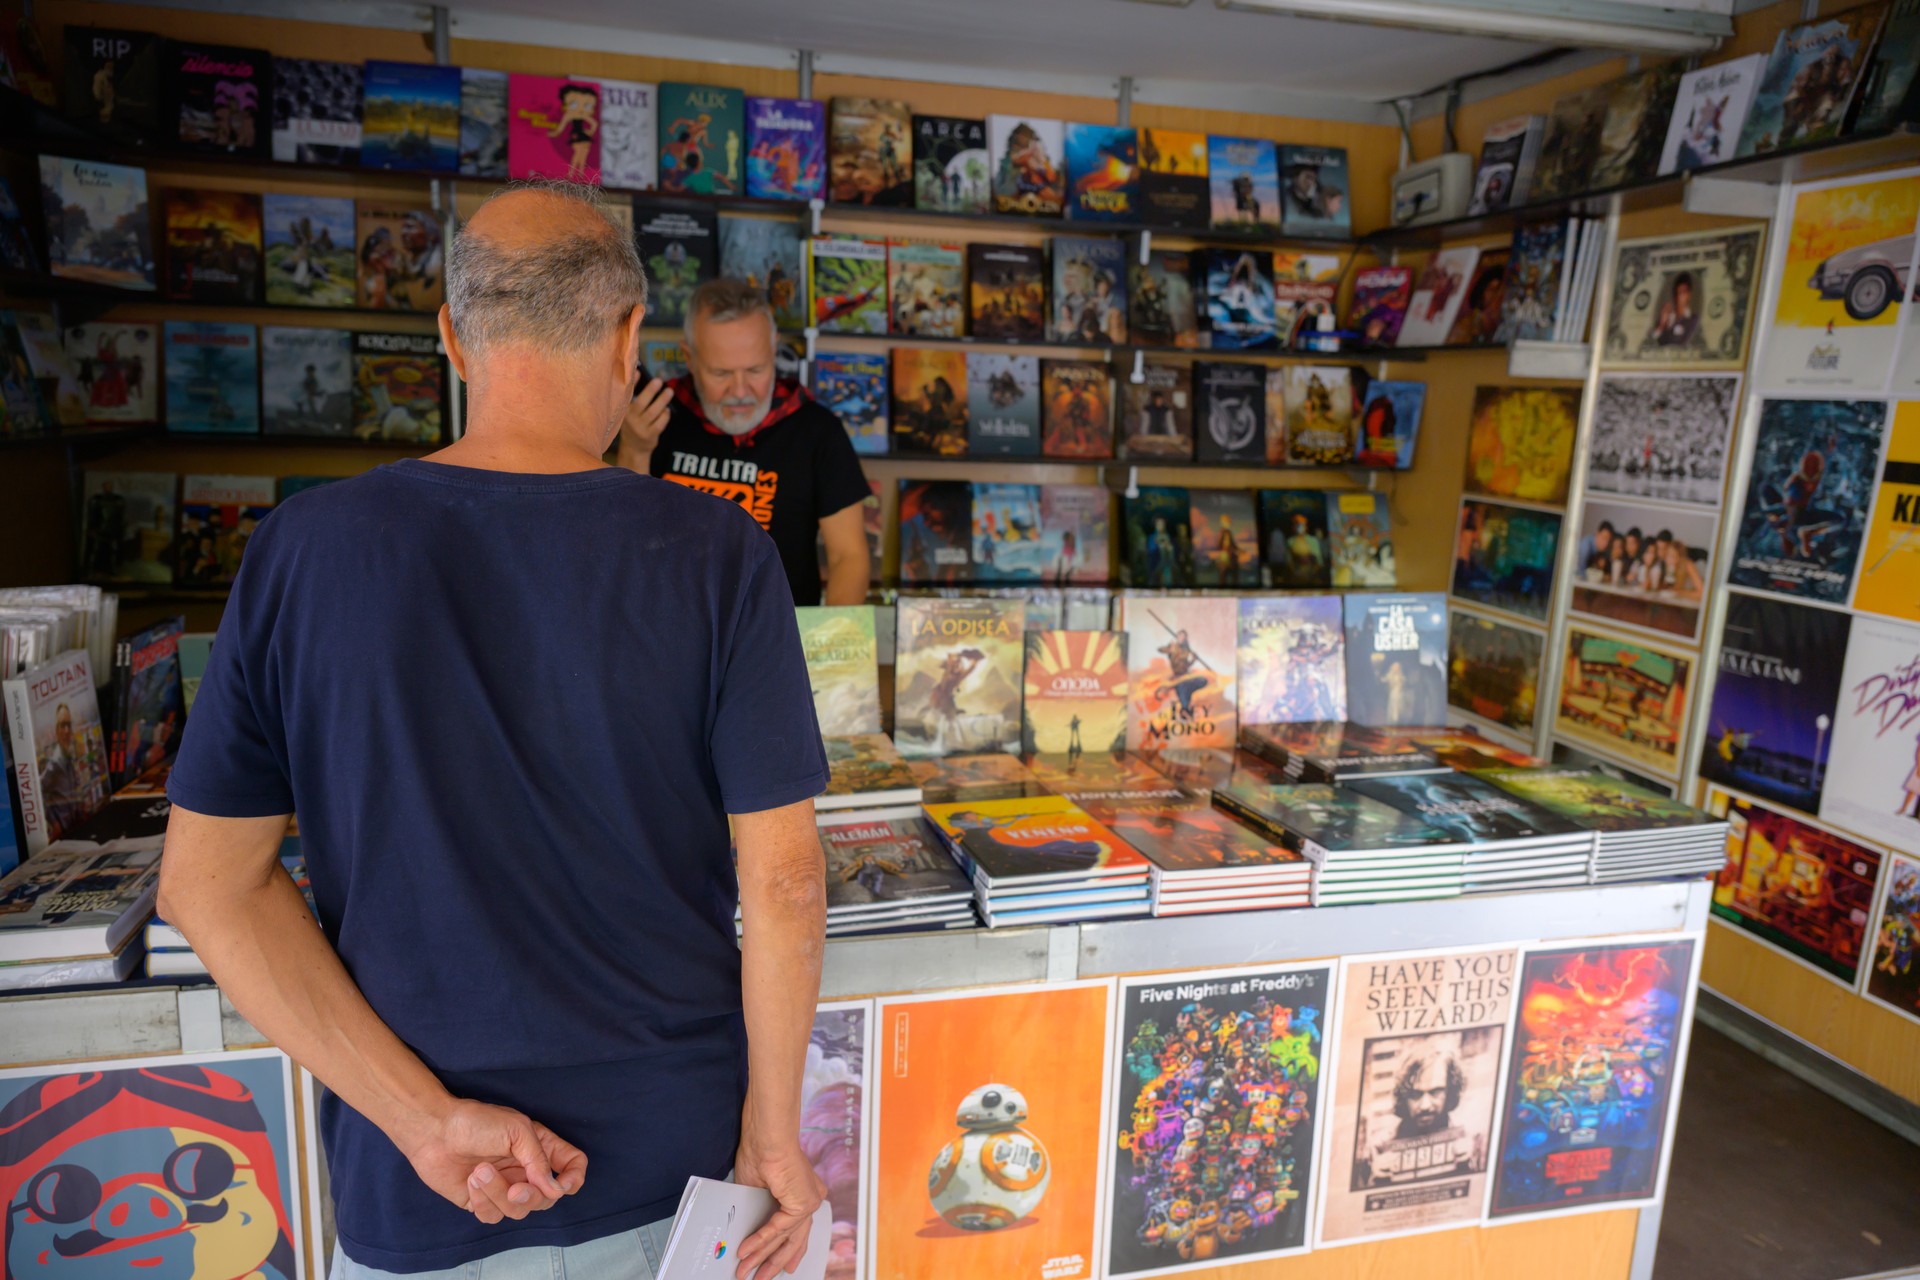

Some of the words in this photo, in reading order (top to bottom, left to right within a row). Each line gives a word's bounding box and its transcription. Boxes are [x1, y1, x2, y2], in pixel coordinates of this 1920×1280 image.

[93, 37, 131, 60] RIP
[921, 121, 983, 141] ARCA
[672, 450, 758, 484] TRILITA
[911, 619, 935, 637] LA
[940, 617, 1011, 637] ODISEA
[1379, 615, 1415, 633] CASA
[1374, 632, 1420, 652] USHER
[31, 660, 87, 702] TOUTAIN
[1051, 676, 1101, 691] ONODA
[1148, 718, 1216, 742] MONO
[18, 762, 38, 835] TOUTAIN
[1005, 824, 1090, 842] VENENO
[1369, 959, 1446, 987] HAVE
[1455, 952, 1514, 979] YOU
[1140, 988, 1174, 1003] Five
[1176, 982, 1228, 1001] Nights
[1230, 980, 1247, 995] at
[1250, 973, 1314, 993] Freddy's
[1366, 984, 1440, 1011] SEEN
[1449, 976, 1511, 1003] THIS
[1376, 1000, 1499, 1032] WIZARD?
[1041, 1254, 1085, 1269] STAR
[1042, 1265, 1084, 1279] WARS
